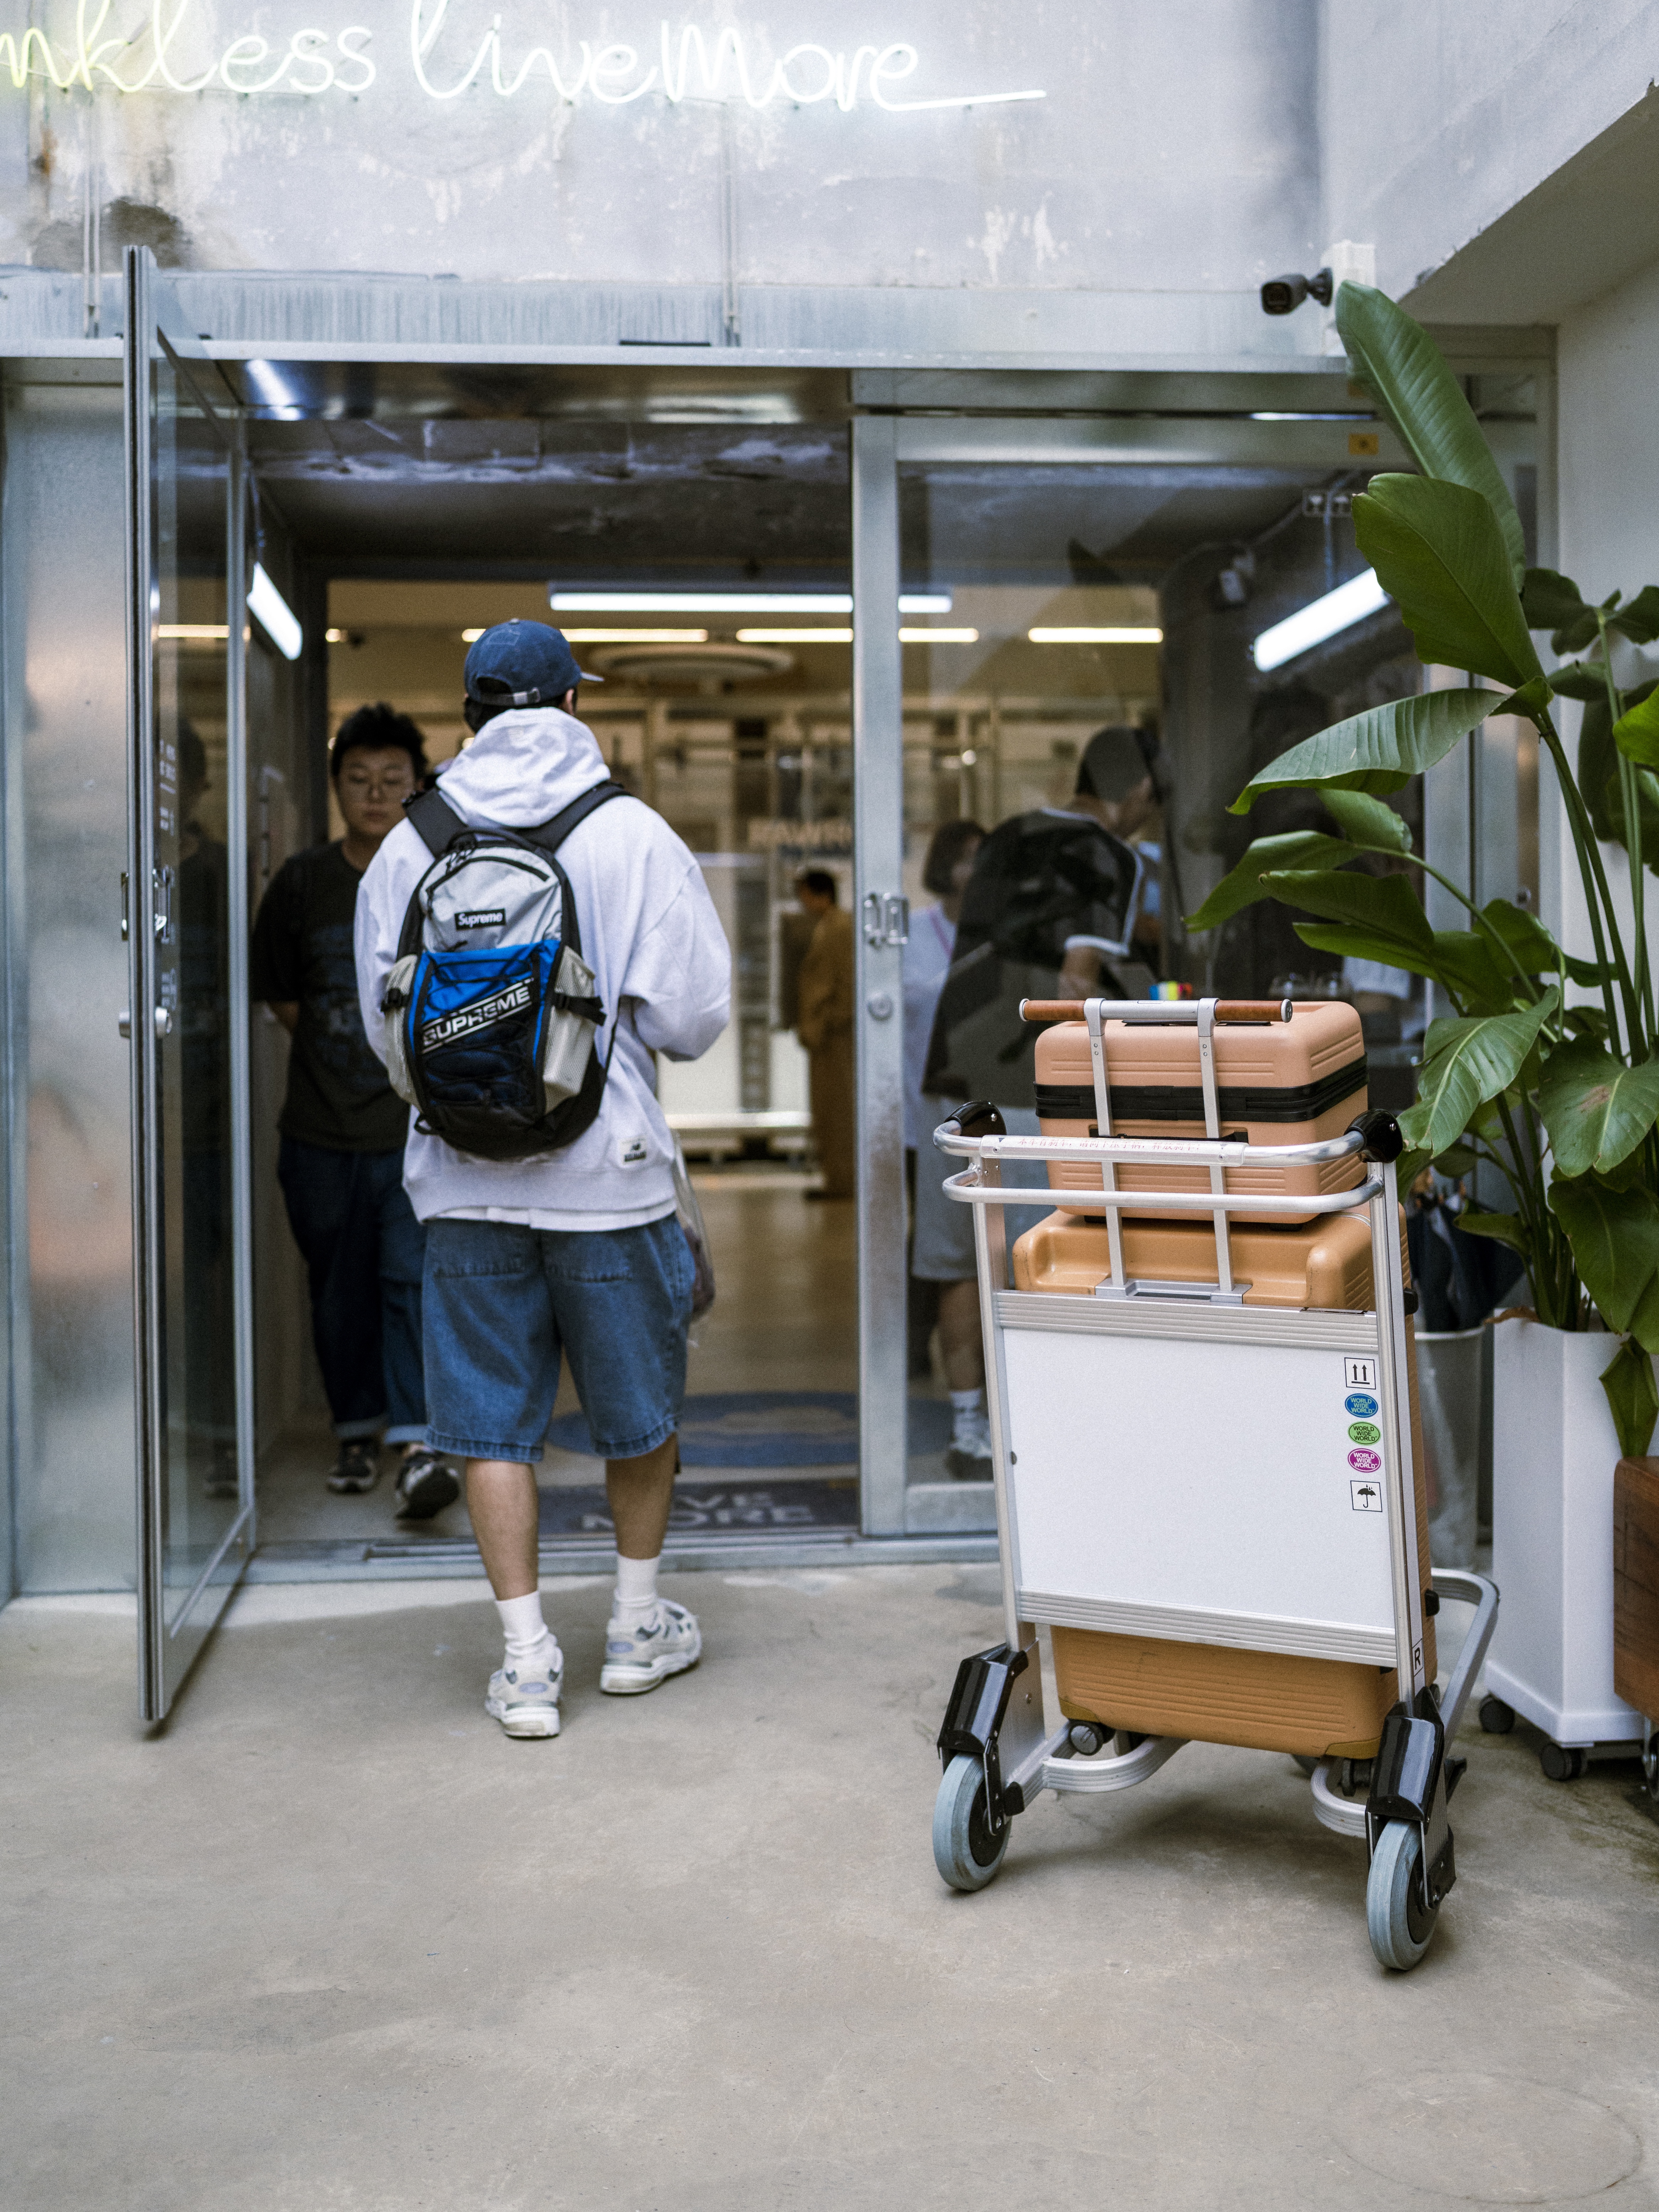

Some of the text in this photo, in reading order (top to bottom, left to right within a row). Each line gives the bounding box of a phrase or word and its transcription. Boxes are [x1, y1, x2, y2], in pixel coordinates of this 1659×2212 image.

[458, 913, 503, 928] Supreme
[423, 986, 530, 1046] SUPREME
[1414, 1647, 1421, 1670] R
